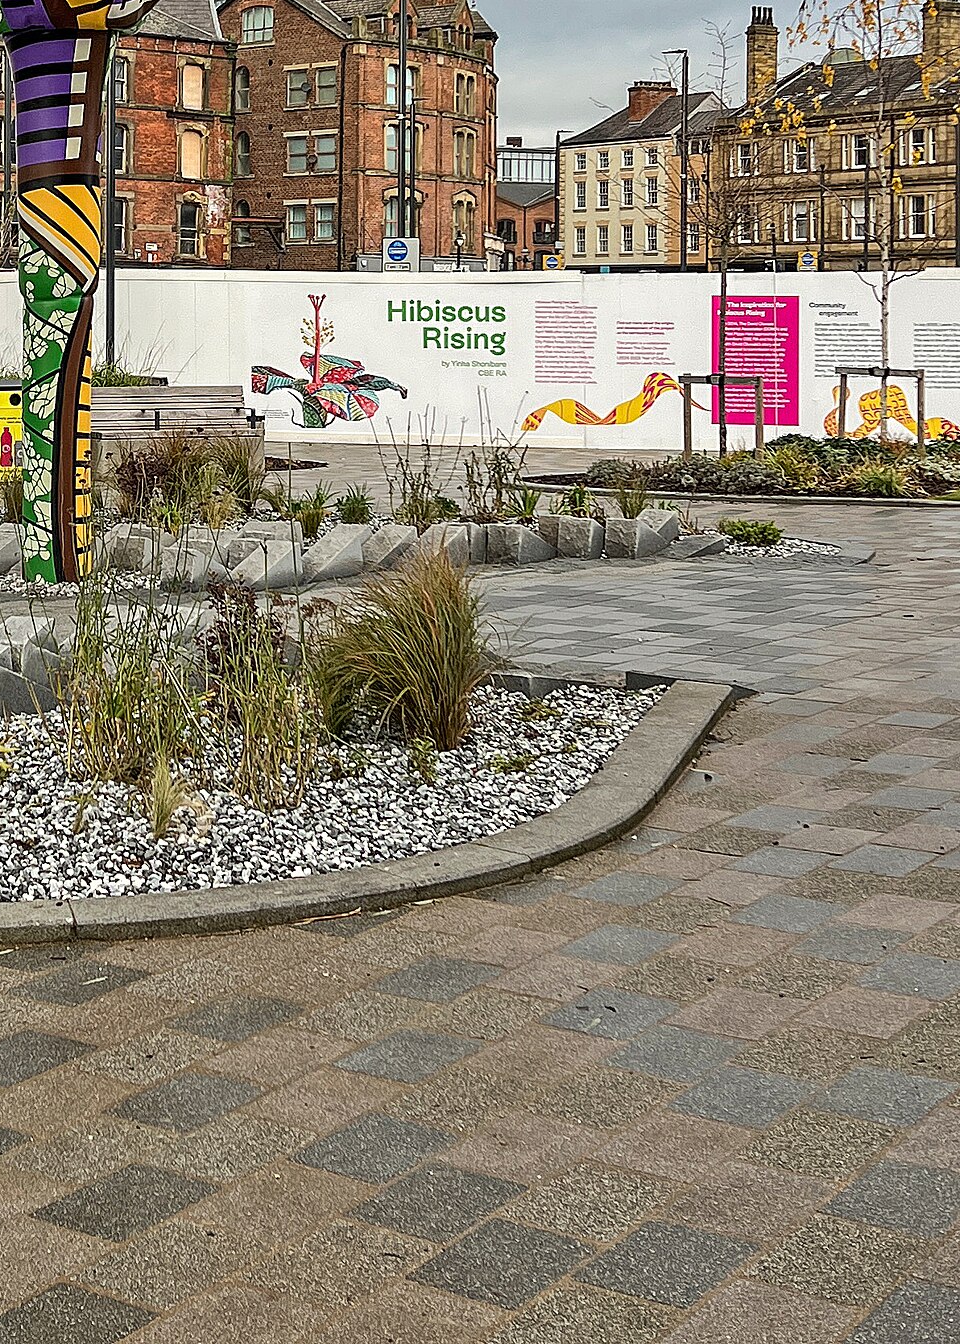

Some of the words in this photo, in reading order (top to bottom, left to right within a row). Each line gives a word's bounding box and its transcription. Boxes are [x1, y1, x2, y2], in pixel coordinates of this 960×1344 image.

[387, 299, 506, 322] Hibiscus
[808, 302, 846, 310] Community
[423, 326, 506, 356] Rising
[441, 360, 450, 369] by
[471, 360, 507, 368] Shonibare
[478, 369, 494, 377] CBE
[496, 369, 507, 377] RA
